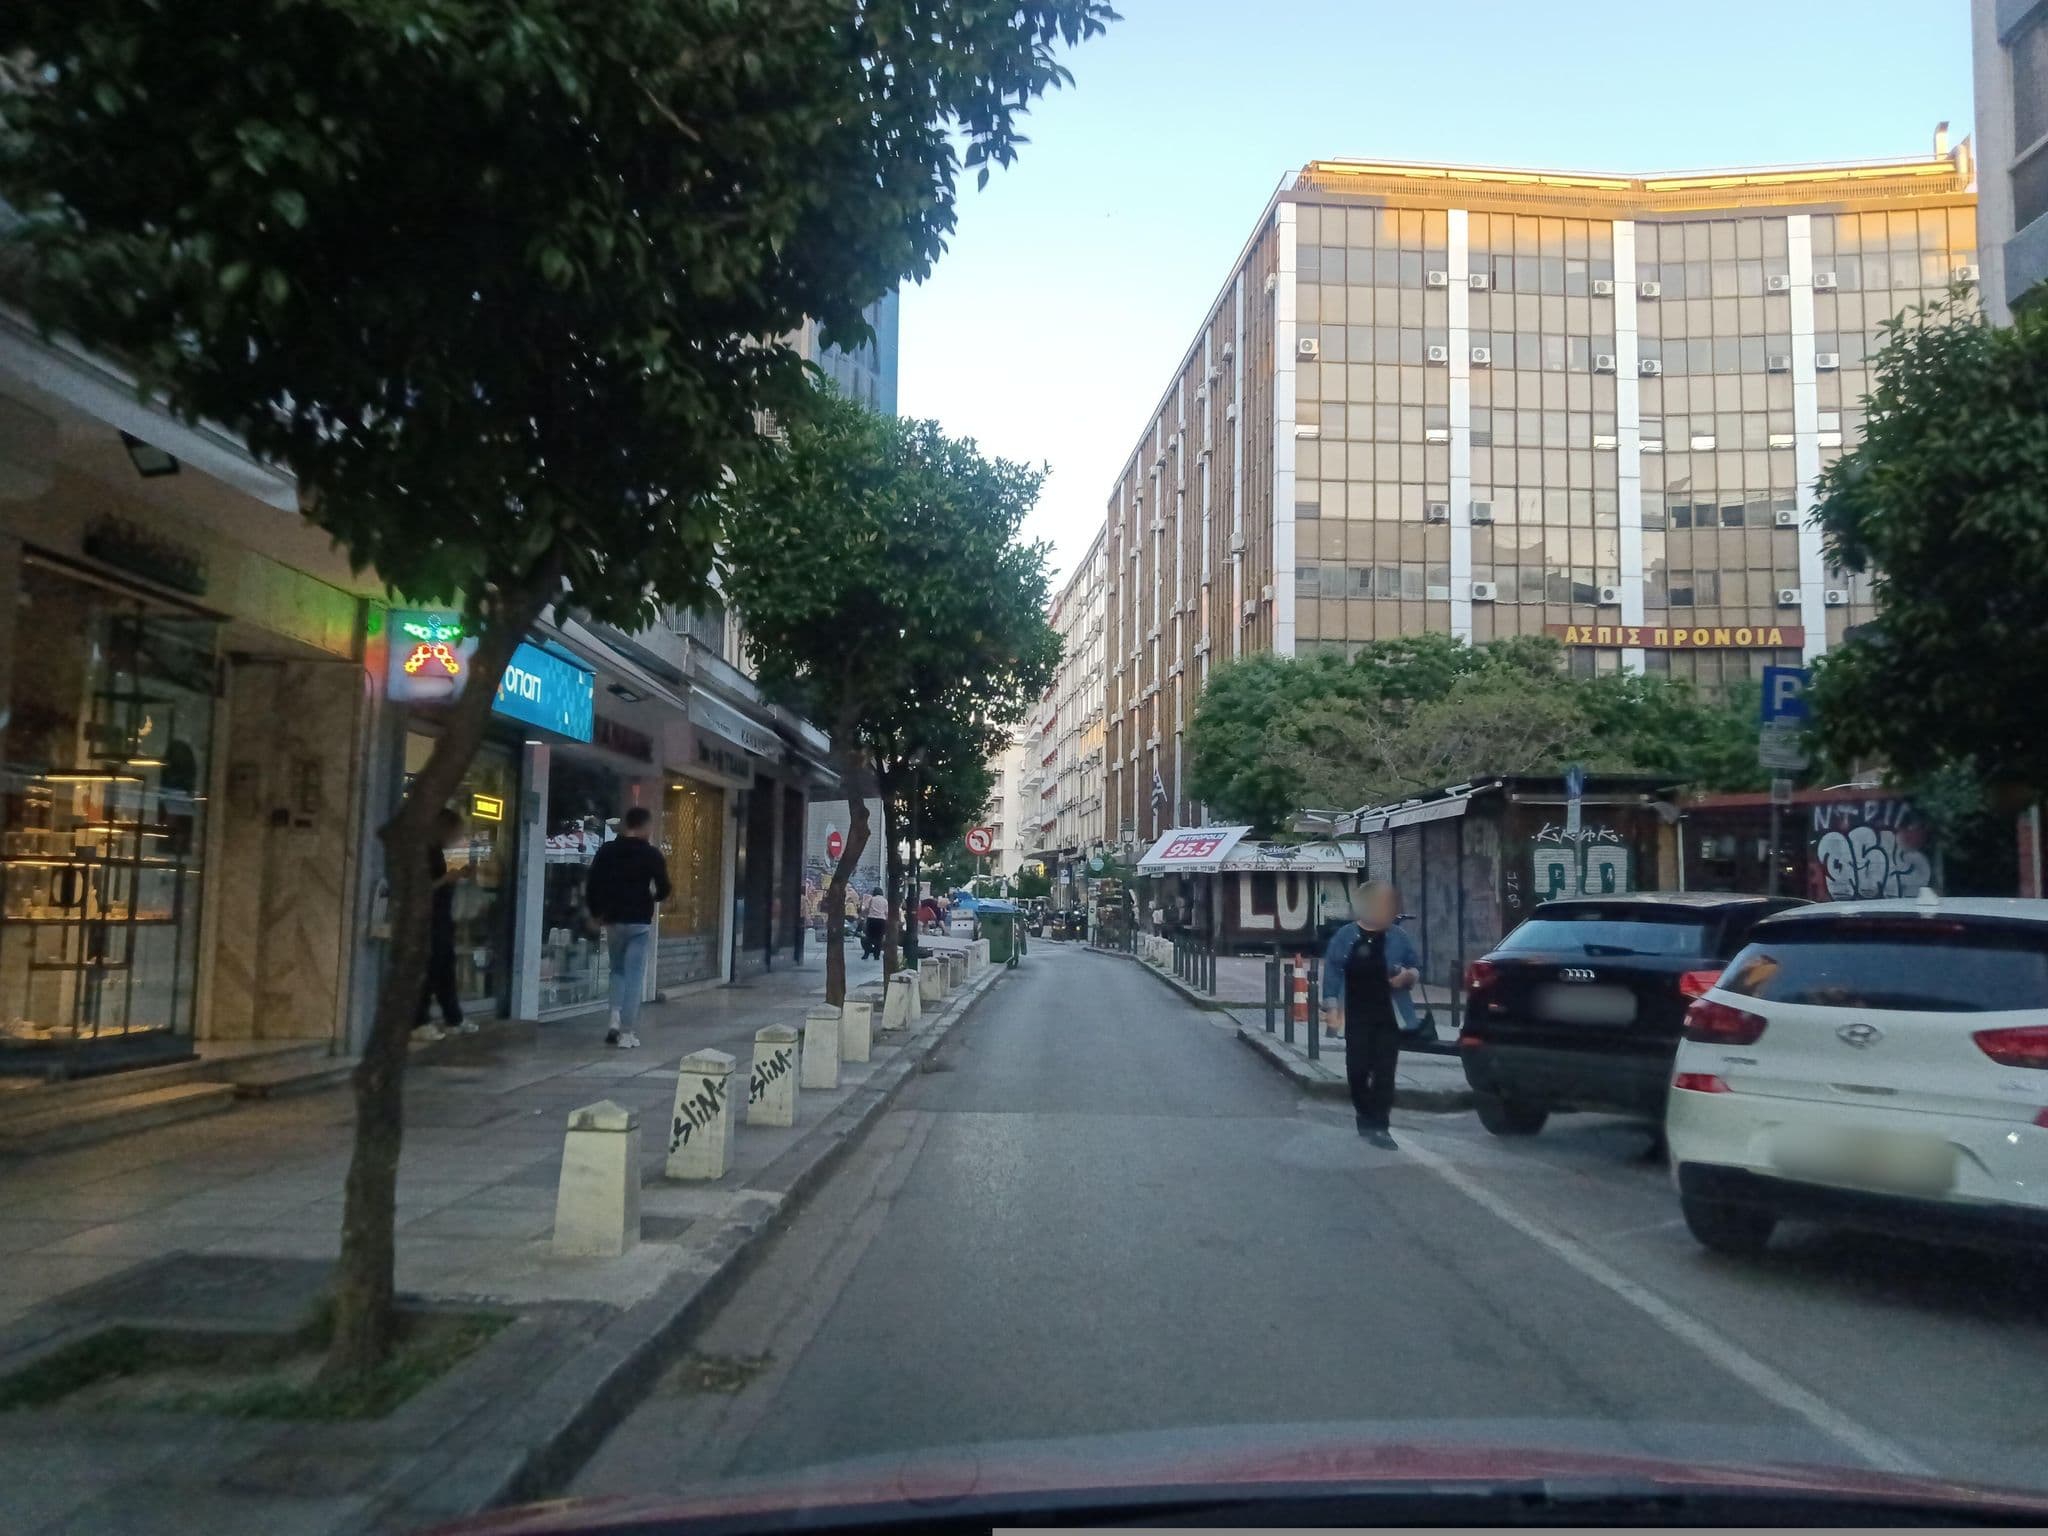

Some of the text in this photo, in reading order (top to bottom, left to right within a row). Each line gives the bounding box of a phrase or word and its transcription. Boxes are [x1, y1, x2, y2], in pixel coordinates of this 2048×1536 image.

[1565, 626, 1784, 646] ΑΣΠΙΣ ΠΡΟΝΟΙΑ
[1773, 673, 1802, 711] P
[1166, 842, 1214, 857] 95.5
